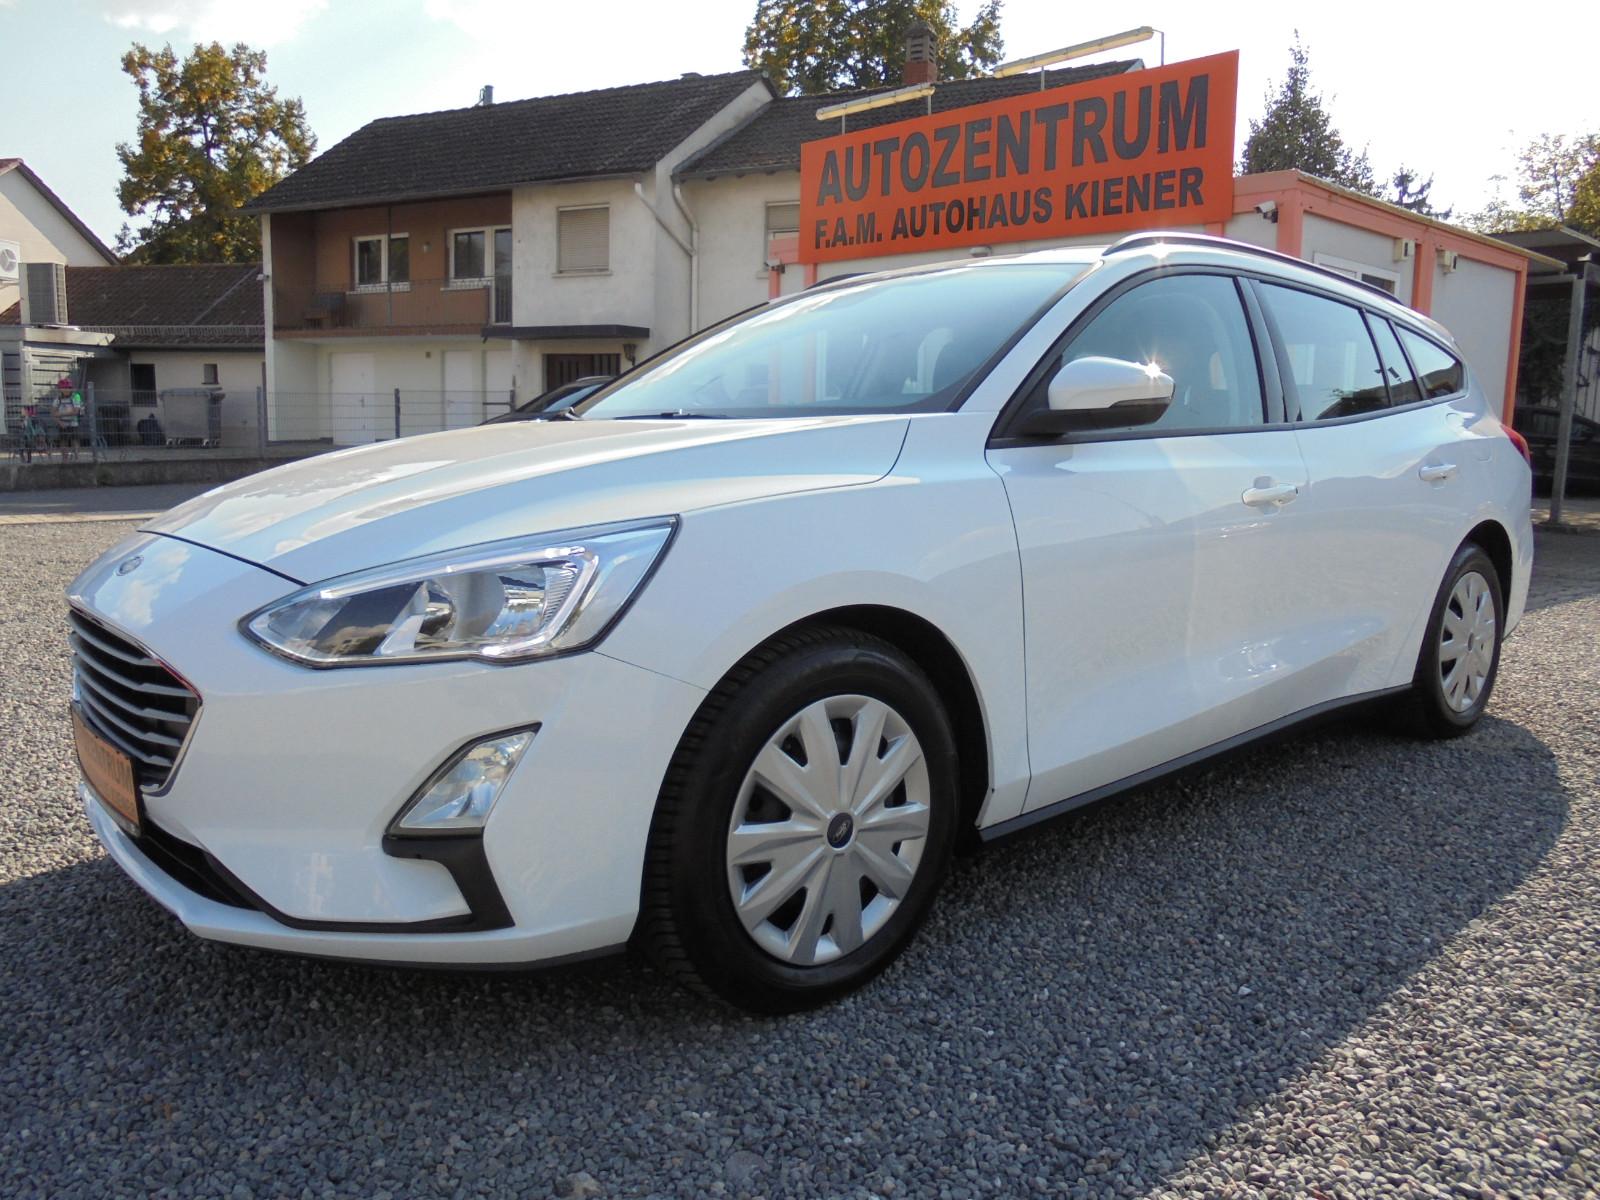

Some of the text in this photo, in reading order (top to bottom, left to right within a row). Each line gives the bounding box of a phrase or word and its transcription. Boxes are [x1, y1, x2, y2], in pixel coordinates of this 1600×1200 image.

[817, 74, 1209, 206] AUTOZENTRUM
[814, 167, 1204, 249] F.A.M. AUTOHAUS KIENER
